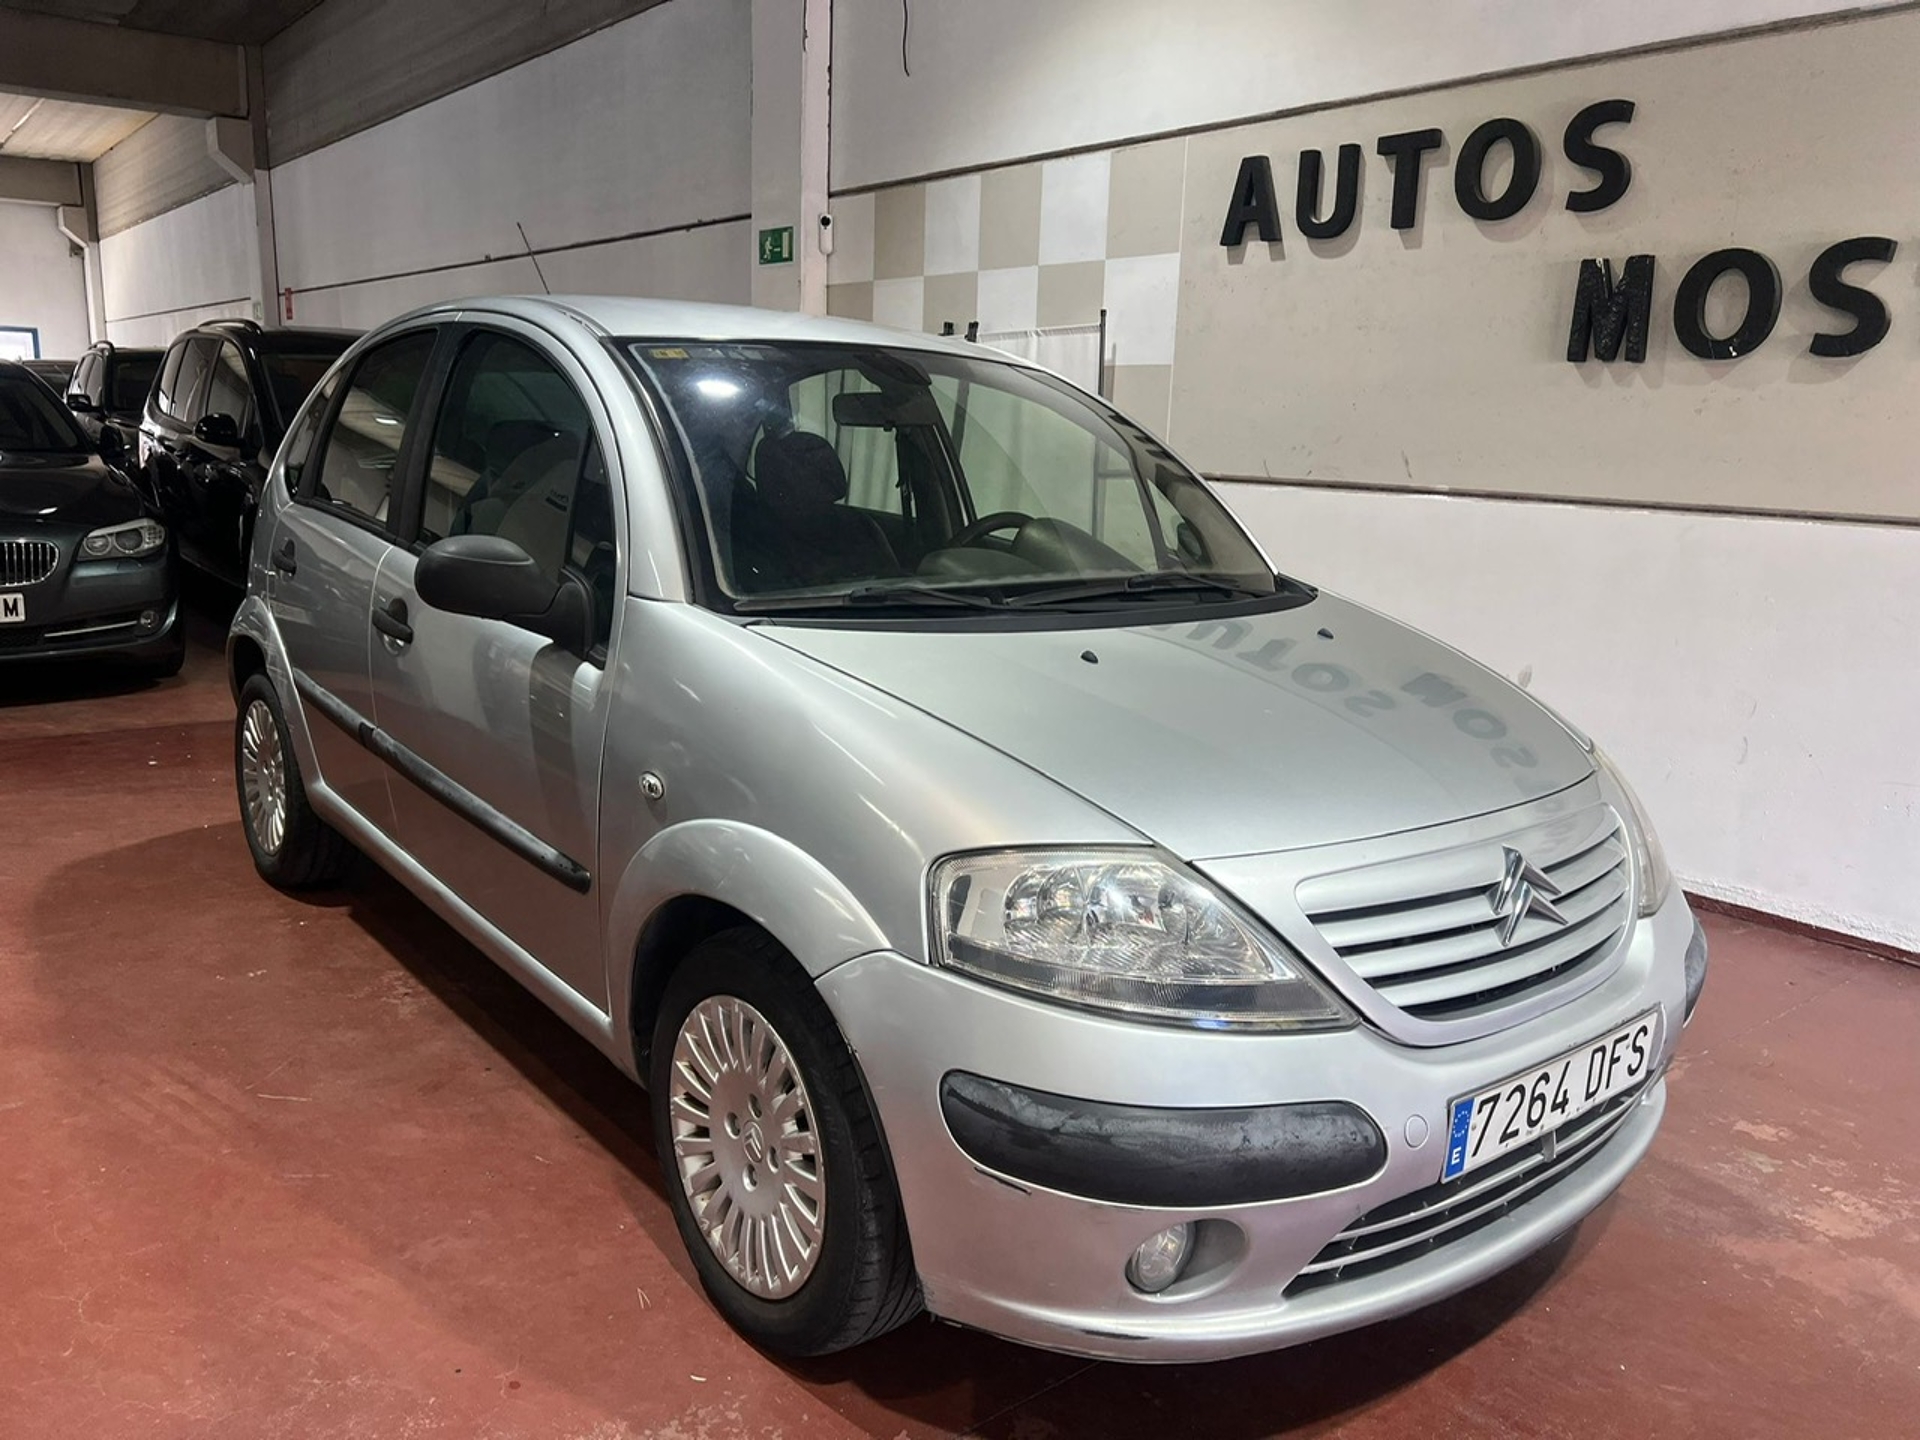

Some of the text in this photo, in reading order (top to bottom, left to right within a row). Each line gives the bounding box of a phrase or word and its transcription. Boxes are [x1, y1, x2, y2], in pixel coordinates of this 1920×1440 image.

[1220, 99, 1636, 246] AUTOS
[1567, 236, 1898, 362] MOS
[1451, 1147, 1462, 1165] E
[1471, 1024, 1649, 1158] 7264 DFS
